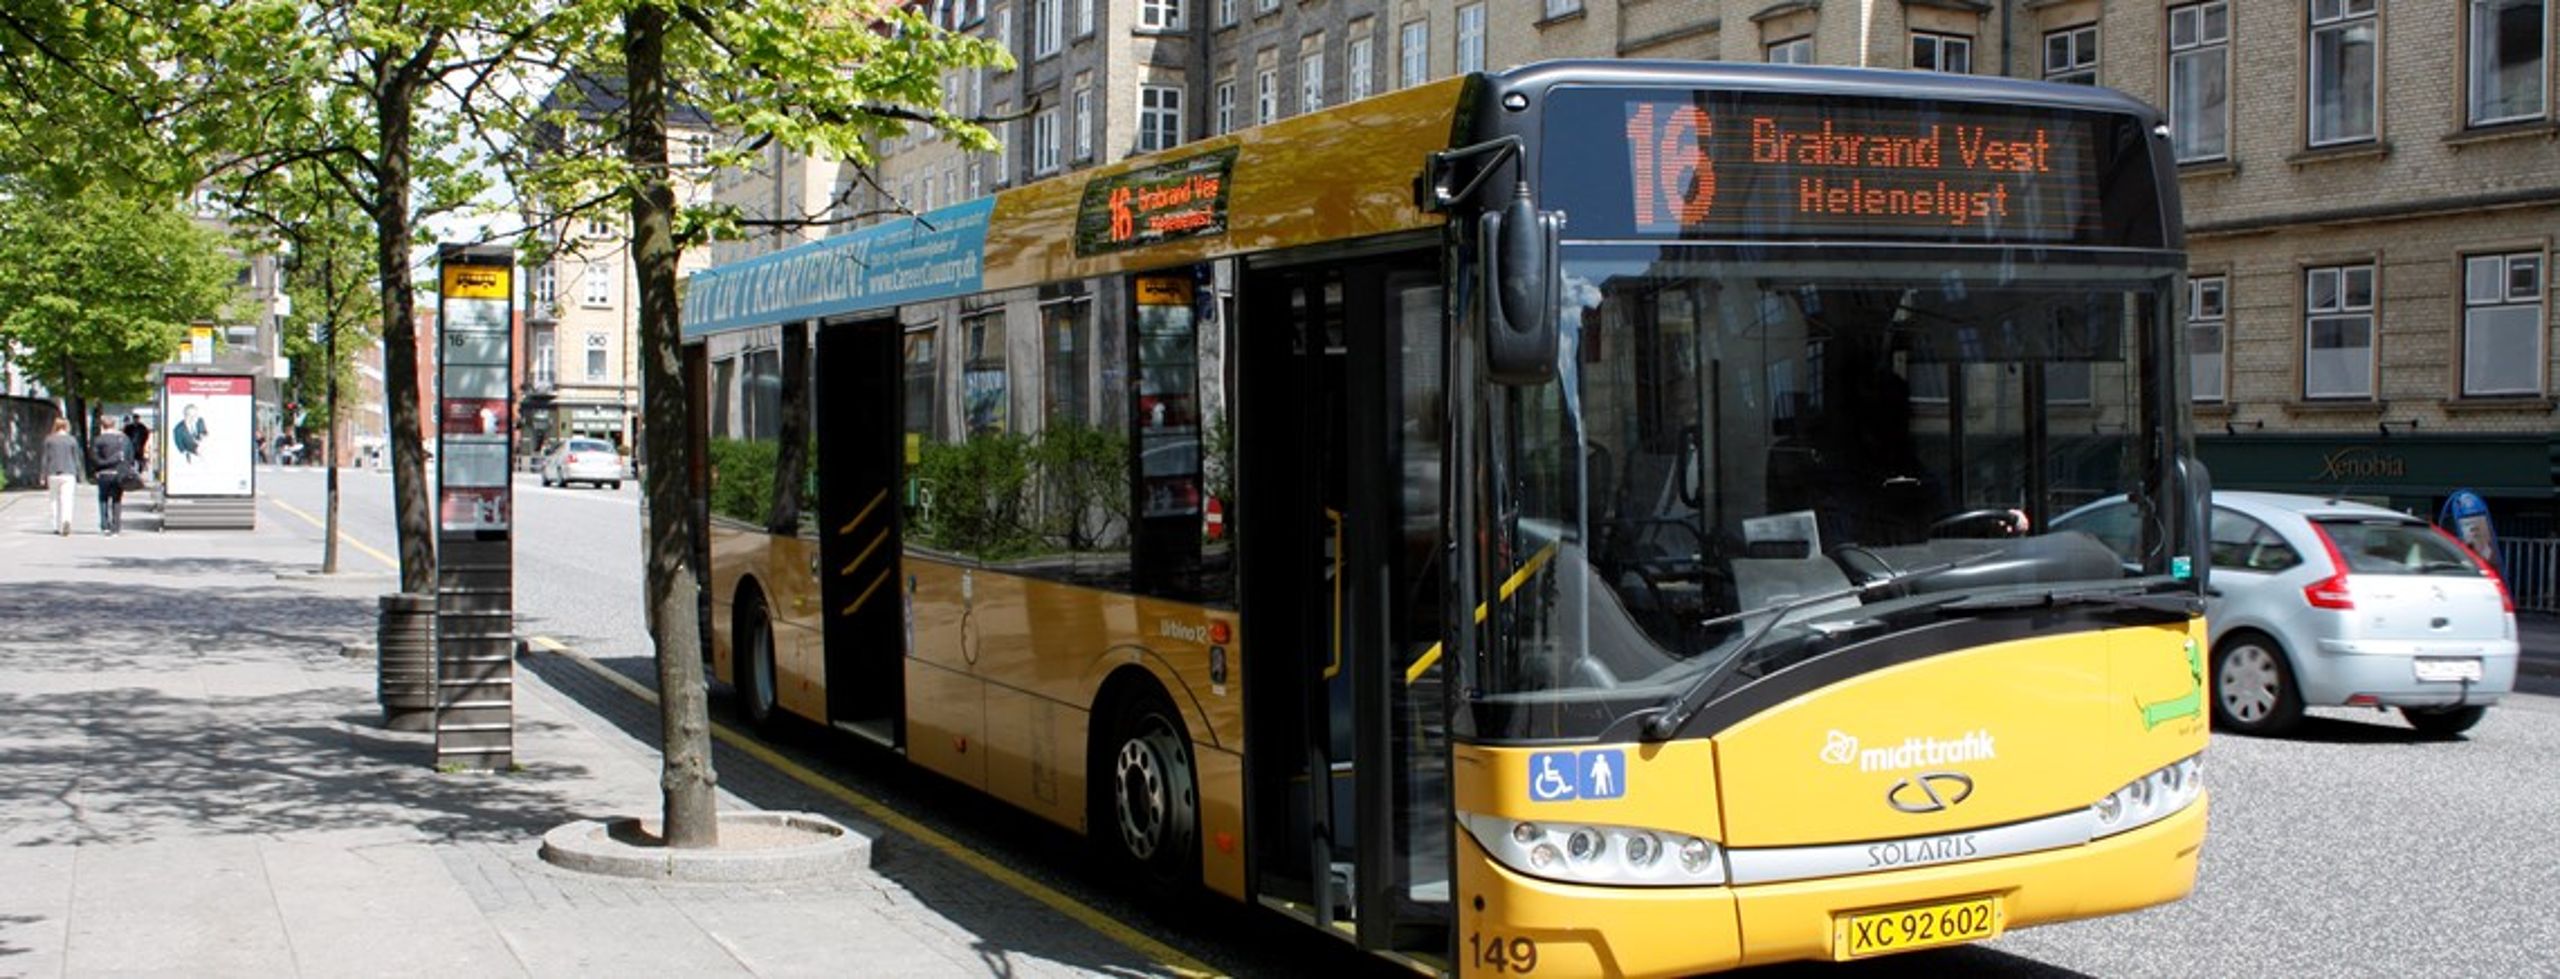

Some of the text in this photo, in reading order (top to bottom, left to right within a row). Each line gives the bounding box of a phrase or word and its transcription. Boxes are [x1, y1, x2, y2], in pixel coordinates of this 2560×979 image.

[1627, 103, 1716, 226] 16
[1752, 116, 2050, 173] Brabrand Vest
[1109, 186, 1133, 242] 16
[1138, 176, 1191, 213] Brabrand
[1800, 177, 2009, 225] Helenelyst
[753, 238, 871, 314] KARRIEREN!
[448, 334, 465, 347] 16
[2312, 447, 2405, 481] Xenobia
[1860, 730, 1996, 772] midttrafik
[1868, 835, 1977, 867] SOLARIS
[1856, 904, 1990, 949] XC 92 602
[1469, 931, 1538, 975] 149
